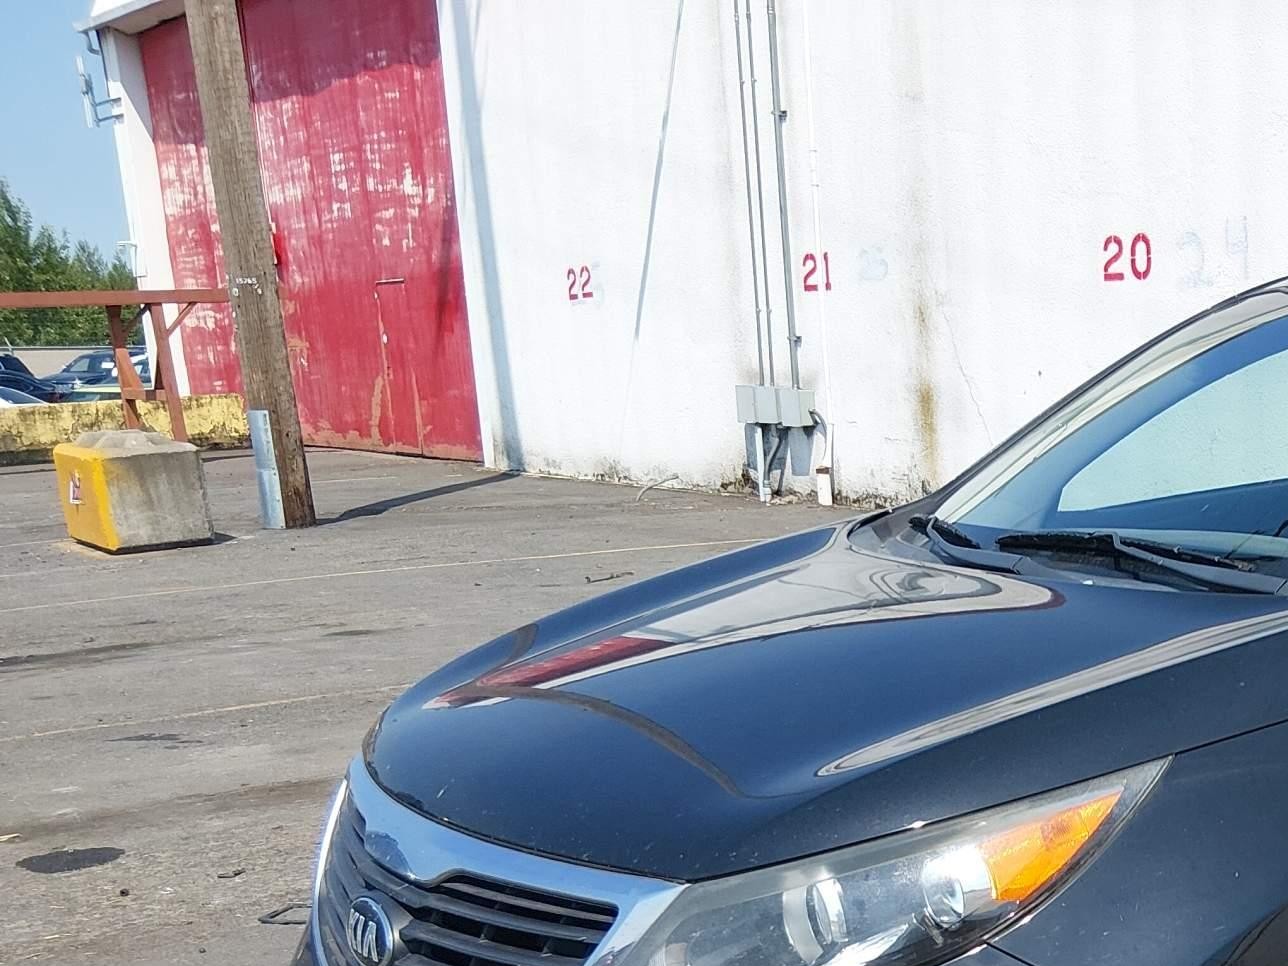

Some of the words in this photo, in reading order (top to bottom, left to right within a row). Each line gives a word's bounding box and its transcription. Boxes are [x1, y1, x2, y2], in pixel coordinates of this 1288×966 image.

[803, 252, 831, 291] 21
[1103, 233, 1151, 281] 20
[567, 265, 593, 300] 22
